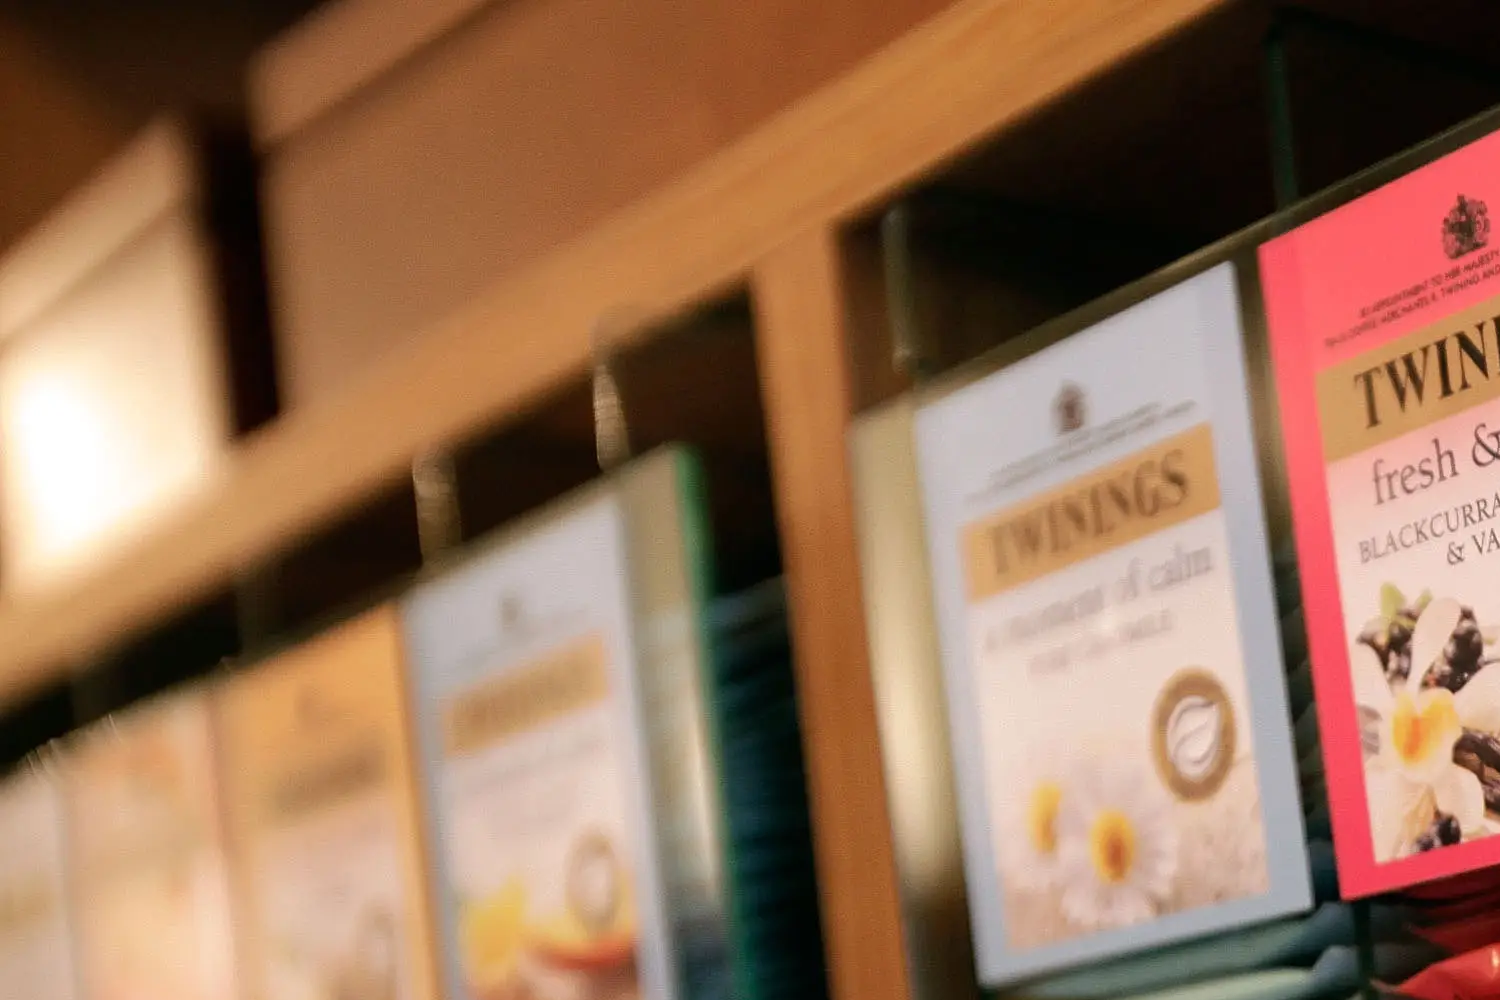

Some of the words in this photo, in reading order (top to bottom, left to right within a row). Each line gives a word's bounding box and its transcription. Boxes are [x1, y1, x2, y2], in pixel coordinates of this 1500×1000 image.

[1372, 438, 1459, 506] fresh
[984, 448, 1190, 575] TWININGS
[1446, 541, 1466, 566] &
